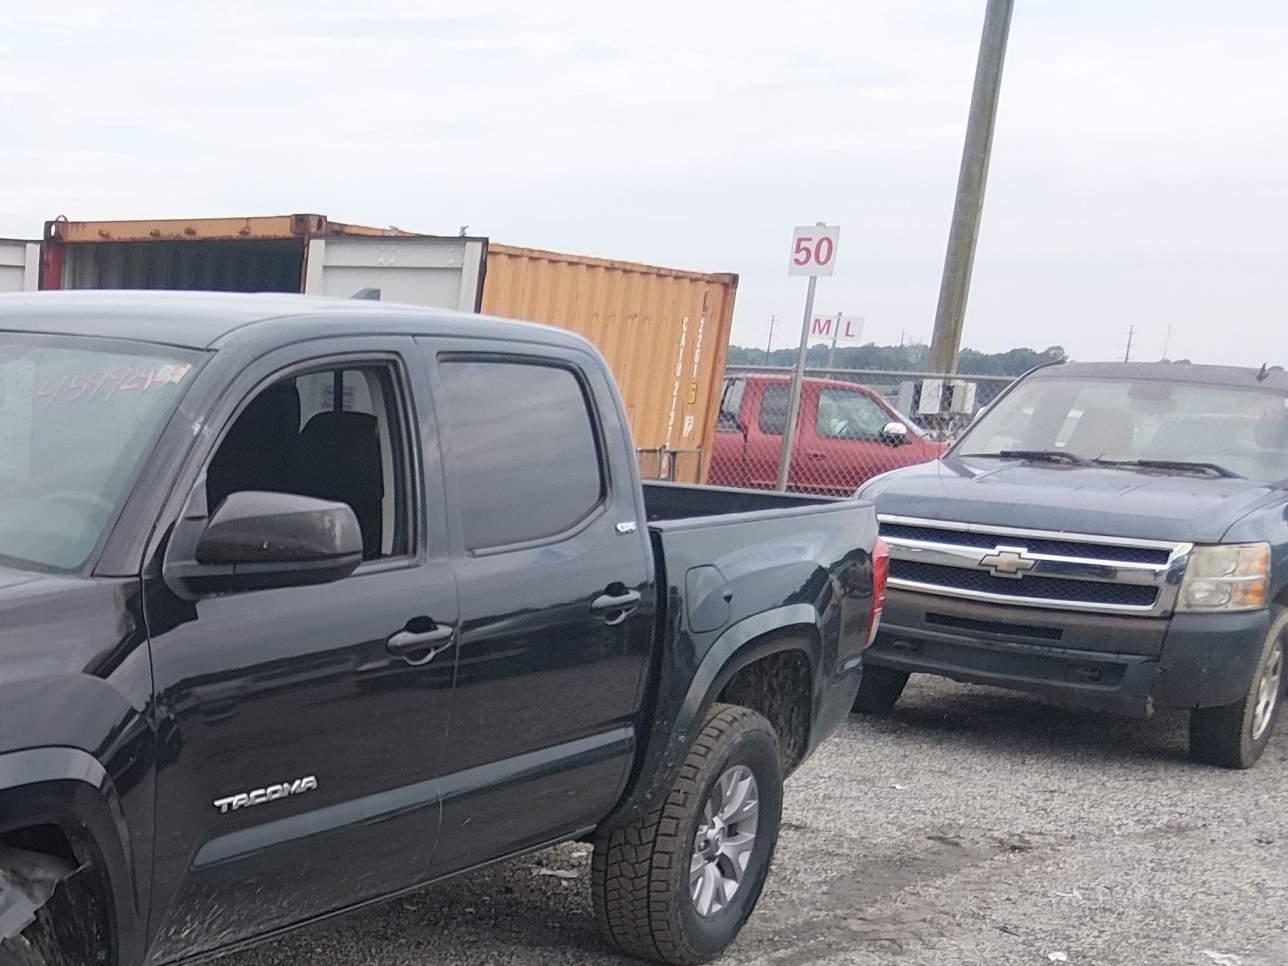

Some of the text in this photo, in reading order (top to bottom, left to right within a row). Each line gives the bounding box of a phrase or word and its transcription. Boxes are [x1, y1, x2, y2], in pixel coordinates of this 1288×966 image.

[793, 236, 833, 266] 50
[812, 318, 855, 338] M L
[213, 775, 318, 814] TACOMA
